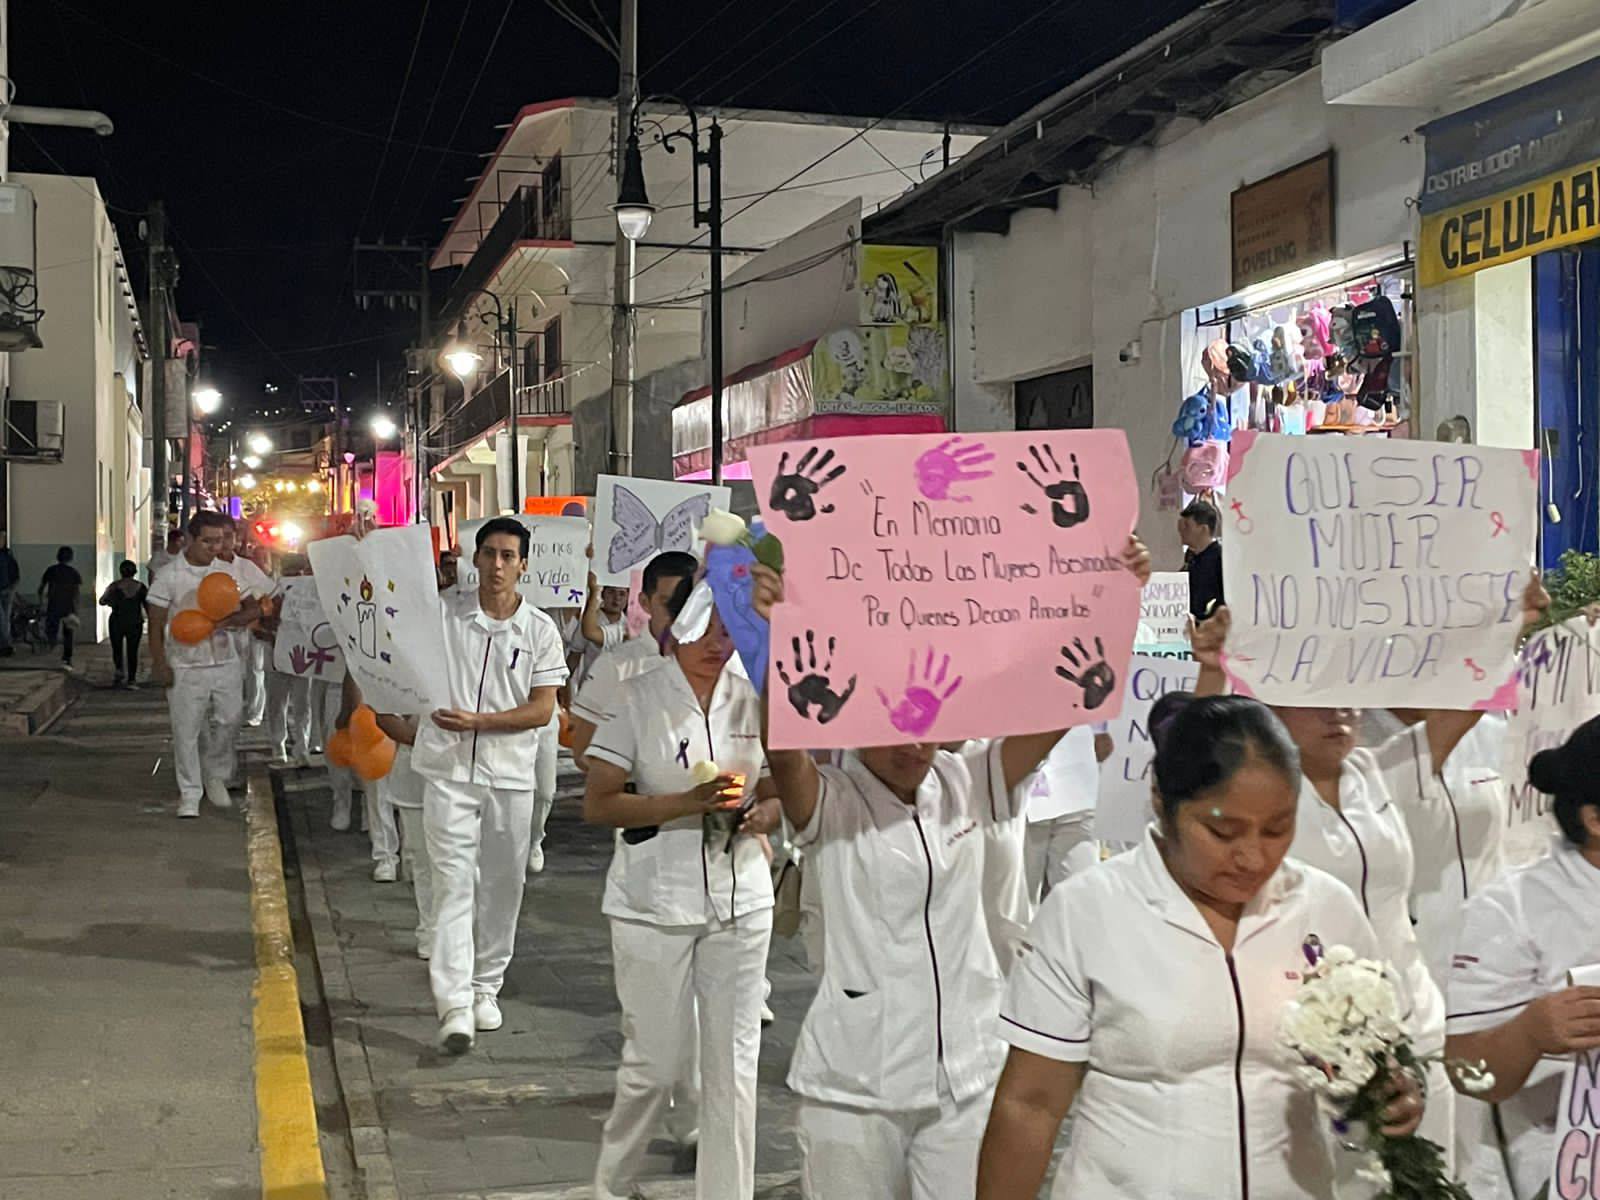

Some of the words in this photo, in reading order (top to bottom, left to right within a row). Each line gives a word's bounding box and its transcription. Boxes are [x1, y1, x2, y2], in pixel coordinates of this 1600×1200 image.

[1440, 166, 1600, 270] CELULAR
[1285, 451, 1360, 515] QUE
[1370, 453, 1482, 509] SER
[913, 501, 1001, 536] Memoria
[1309, 512, 1441, 571] MUJER
[826, 548, 863, 581] De
[876, 549, 934, 582] Todas
[944, 550, 977, 582] Las
[982, 552, 1040, 582] Mujeres
[862, 595, 890, 626] Por
[900, 596, 960, 630] Quienes
[1251, 574, 1299, 630] NO
[1315, 575, 1391, 630] NOS
[1260, 634, 1319, 685] LA
[1348, 633, 1443, 685] VIDA
[1128, 719, 1149, 743] N
